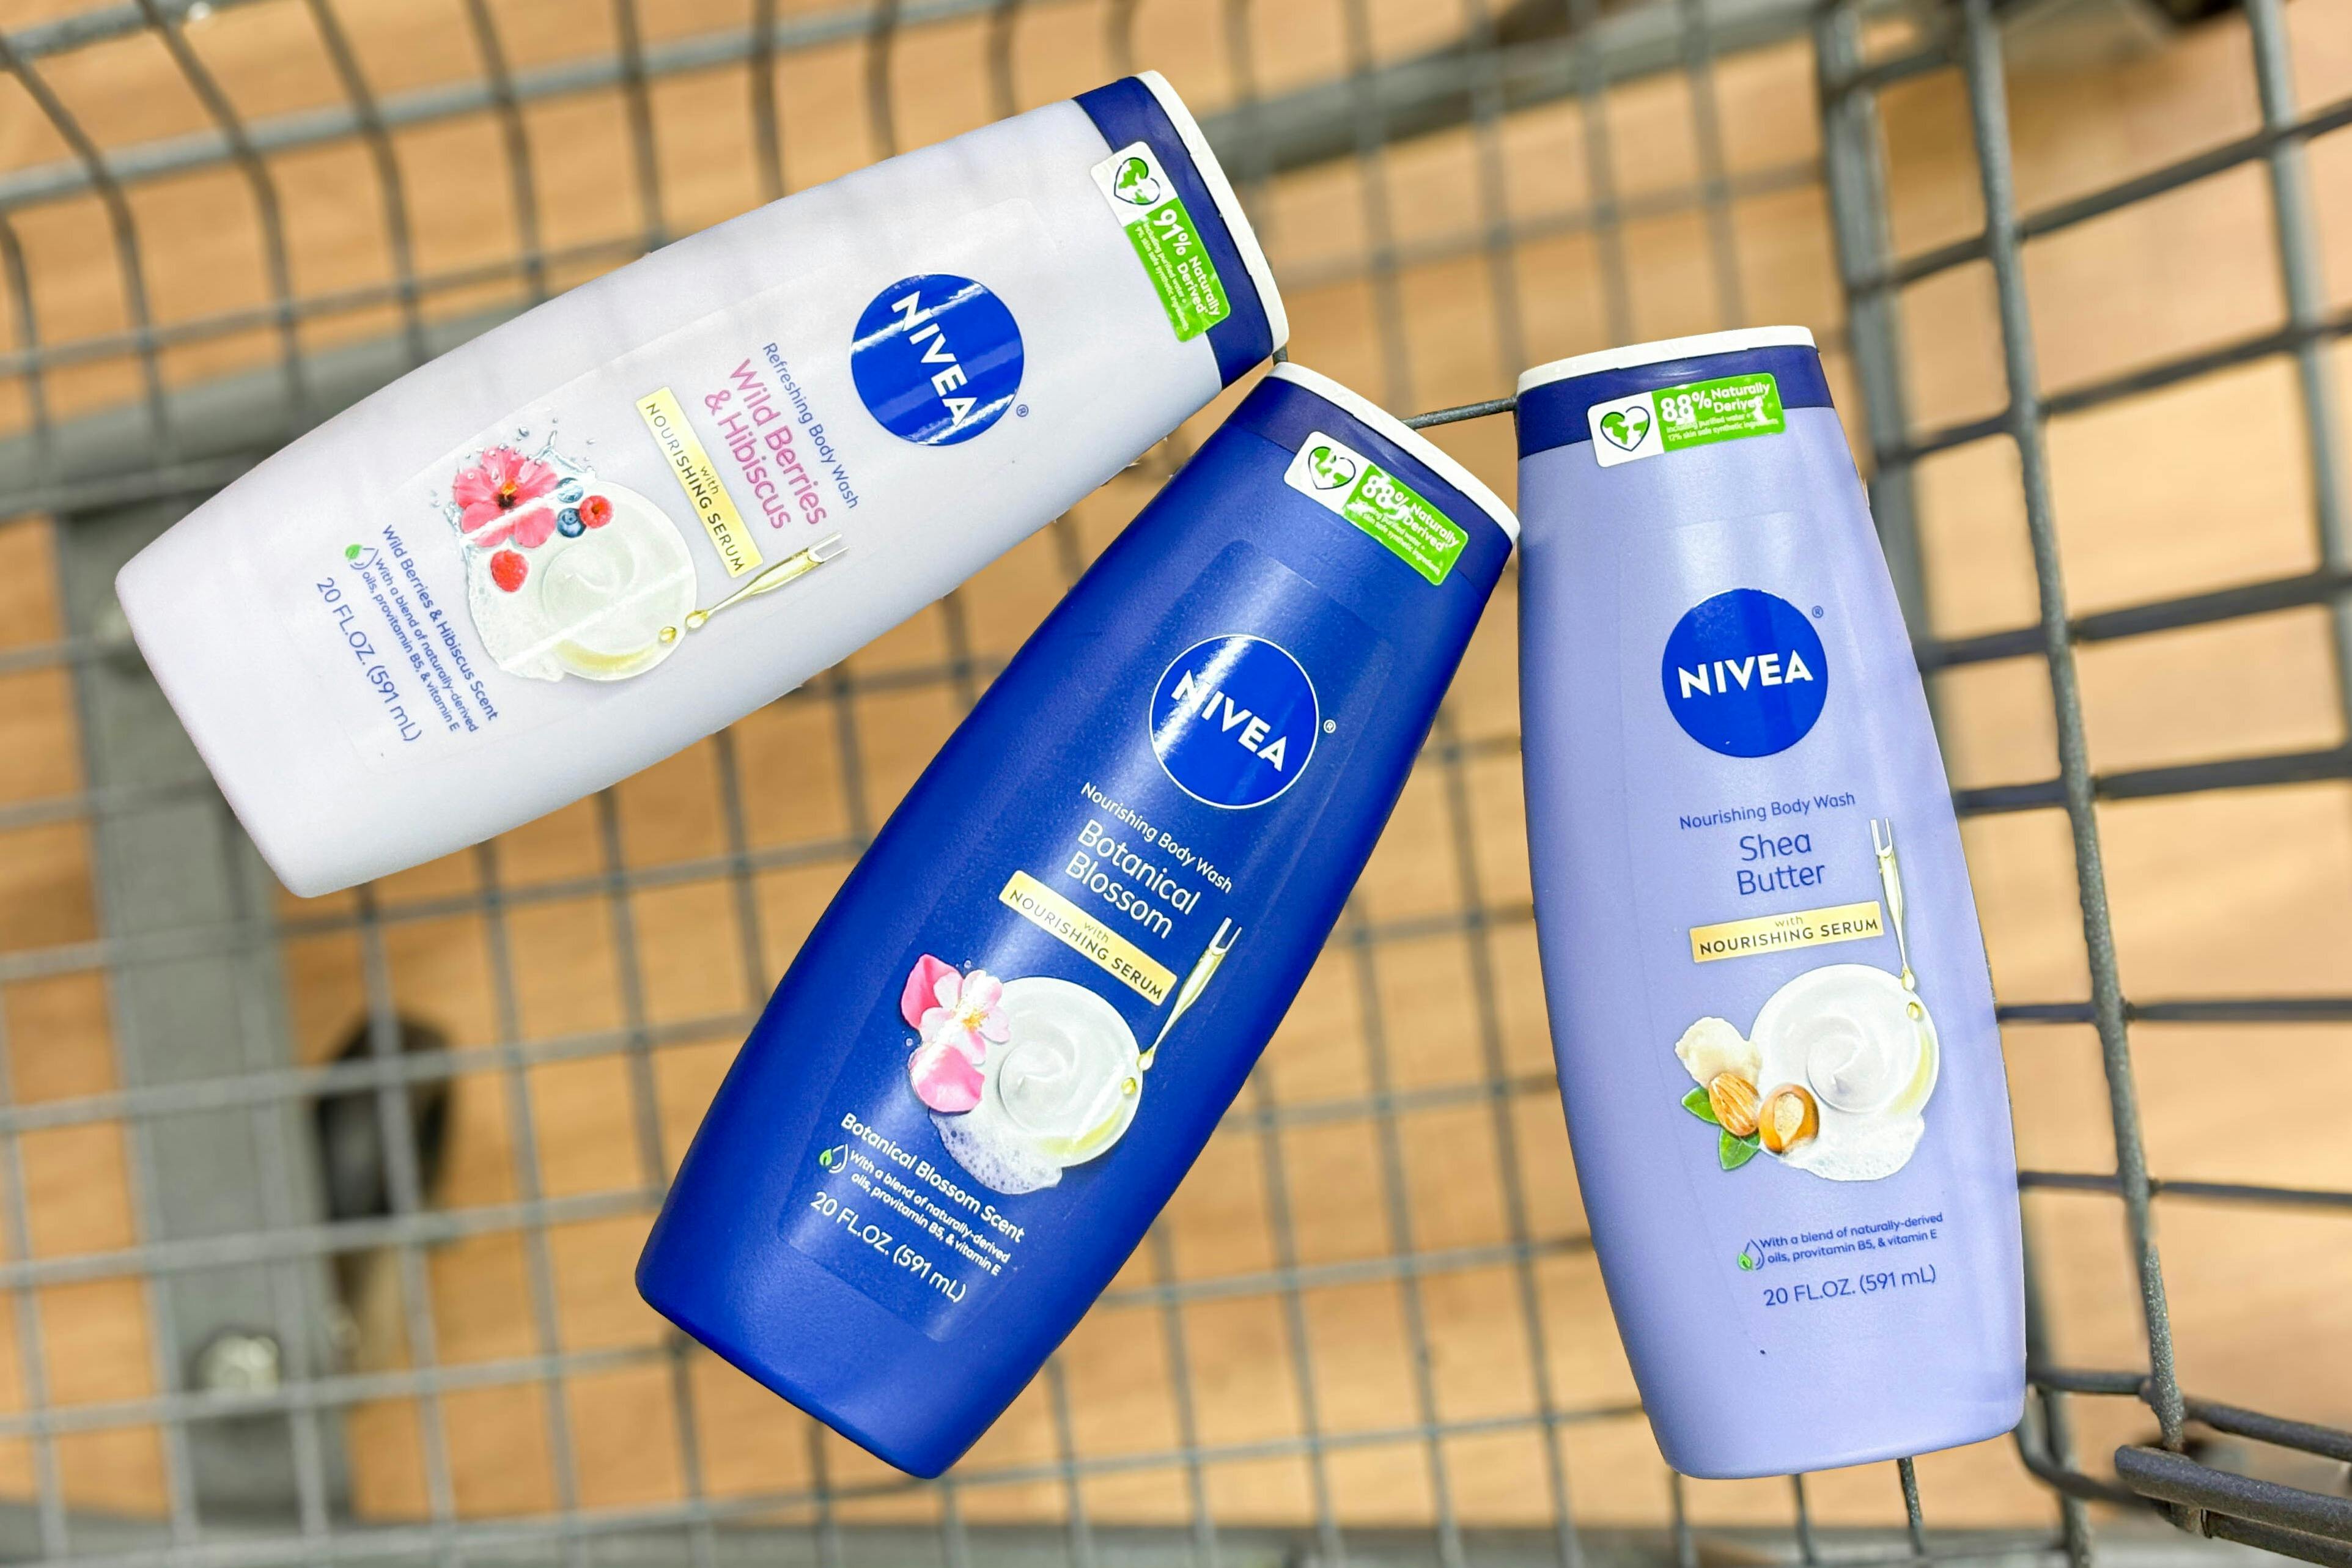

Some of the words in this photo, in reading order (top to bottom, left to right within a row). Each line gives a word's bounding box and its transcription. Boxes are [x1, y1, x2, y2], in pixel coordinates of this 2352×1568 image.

[1152, 208, 1192, 256] 91%
[1140, 237, 1151, 252] skin
[1148, 251, 1159, 266] safe
[1155, 265, 1174, 296] synthetic
[1170, 295, 1189, 331] ingredients
[1171, 278, 1184, 297] water
[1184, 255, 1220, 315] Naturally
[890, 290, 978, 427] NIVEA
[704, 389, 731, 416] &
[1659, 389, 1712, 423] 88%
[1710, 381, 1770, 400] Naturally
[729, 358, 781, 427] Wild
[763, 425, 827, 525] Berries
[762, 342, 814, 424] Refreshing
[808, 423, 836, 463] Body
[831, 463, 858, 509] Wash
[1697, 427, 1712, 436] safe
[1712, 422, 1742, 434] synthetic
[646, 403, 712, 509] NOURISHING
[707, 512, 744, 571] SERUM
[700, 465, 719, 495] with
[717, 411, 791, 529] Hibiscus
[382, 524, 407, 558] Wild
[1404, 502, 1459, 548] Naturally
[400, 558, 434, 609] Berries
[429, 609, 442, 622] &
[316, 576, 341, 603] 20
[332, 603, 375, 665] FL.OZ.
[366, 664, 399, 704] (591
[389, 705, 422, 742] mL)
[361, 571, 377, 594] oils,
[372, 593, 413, 653] provitamin
[409, 652, 424, 672] B5,
[419, 671, 430, 682] &
[426, 681, 452, 723] vitamin
[448, 721, 460, 731] E
[375, 557, 393, 586] With
[389, 587, 399, 595] a
[395, 595, 419, 628] blend
[413, 628, 428, 641] of
[421, 641, 479, 732] naturally-derived
[435, 620, 474, 680] Hibiscus
[1678, 649, 1813, 699] NIVEA
[470, 680, 498, 721] Scent
[1170, 669, 1286, 772] NIVEA
[1679, 806, 1766, 830] Nourishing
[1770, 798, 1810, 816] Body
[1813, 791, 1856, 809] Wash
[1080, 781, 1158, 842] Nourishing
[1157, 831, 1196, 866] Body
[1196, 856, 1232, 893] Wash
[1739, 833, 1812, 861] Shea
[1075, 818, 1201, 915] Botanical
[1736, 864, 1825, 896] Butter
[1063, 847, 1172, 939] Blossom
[1009, 889, 1109, 960] NOURISHING
[1110, 957, 1162, 999] SERUM
[1083, 921, 1108, 943] with
[1698, 927, 1813, 955] NOURISHING
[1819, 918, 1878, 937] SERUM
[1774, 915, 1804, 927] with
[841, 1112, 918, 1169] Botanical
[915, 1160, 981, 1213] Blossom
[980, 1205, 1025, 1243] Scent
[849, 1149, 874, 1174] With
[874, 1169, 883, 1179] a
[882, 1172, 915, 1199] blend
[913, 1194, 929, 1207] of
[924, 1202, 1011, 1264] naturally-derived
[850, 1172, 871, 1192] oils,
[869, 1185, 928, 1228] provitamin
[927, 1221, 945, 1241] B5,
[945, 1233, 954, 1246] &
[954, 1240, 992, 1271] vitamin
[990, 1264, 1001, 1276] E
[1758, 1236, 1788, 1248] With
[1800, 1229, 1834, 1243] blend
[1835, 1226, 1848, 1238] of
[1849, 1212, 1943, 1236] naturally-derived
[810, 1191, 838, 1216] 20
[835, 1207, 893, 1256] FL.OZ.
[893, 1243, 932, 1278] (591
[928, 1271, 966, 1303] mL)
[1767, 1251, 1791, 1264] oils,
[1792, 1243, 1856, 1262] provitamin
[1857, 1239, 1876, 1251] B5,
[1877, 1237, 1886, 1248] &
[1887, 1232, 1928, 1246] vitamin
[1930, 1228, 1937, 1239] E
[1763, 1287, 1788, 1306] 20
[1793, 1278, 1856, 1302] FL.OZ.
[1859, 1271, 1896, 1294] (591
[1901, 1264, 1936, 1286] mL)
